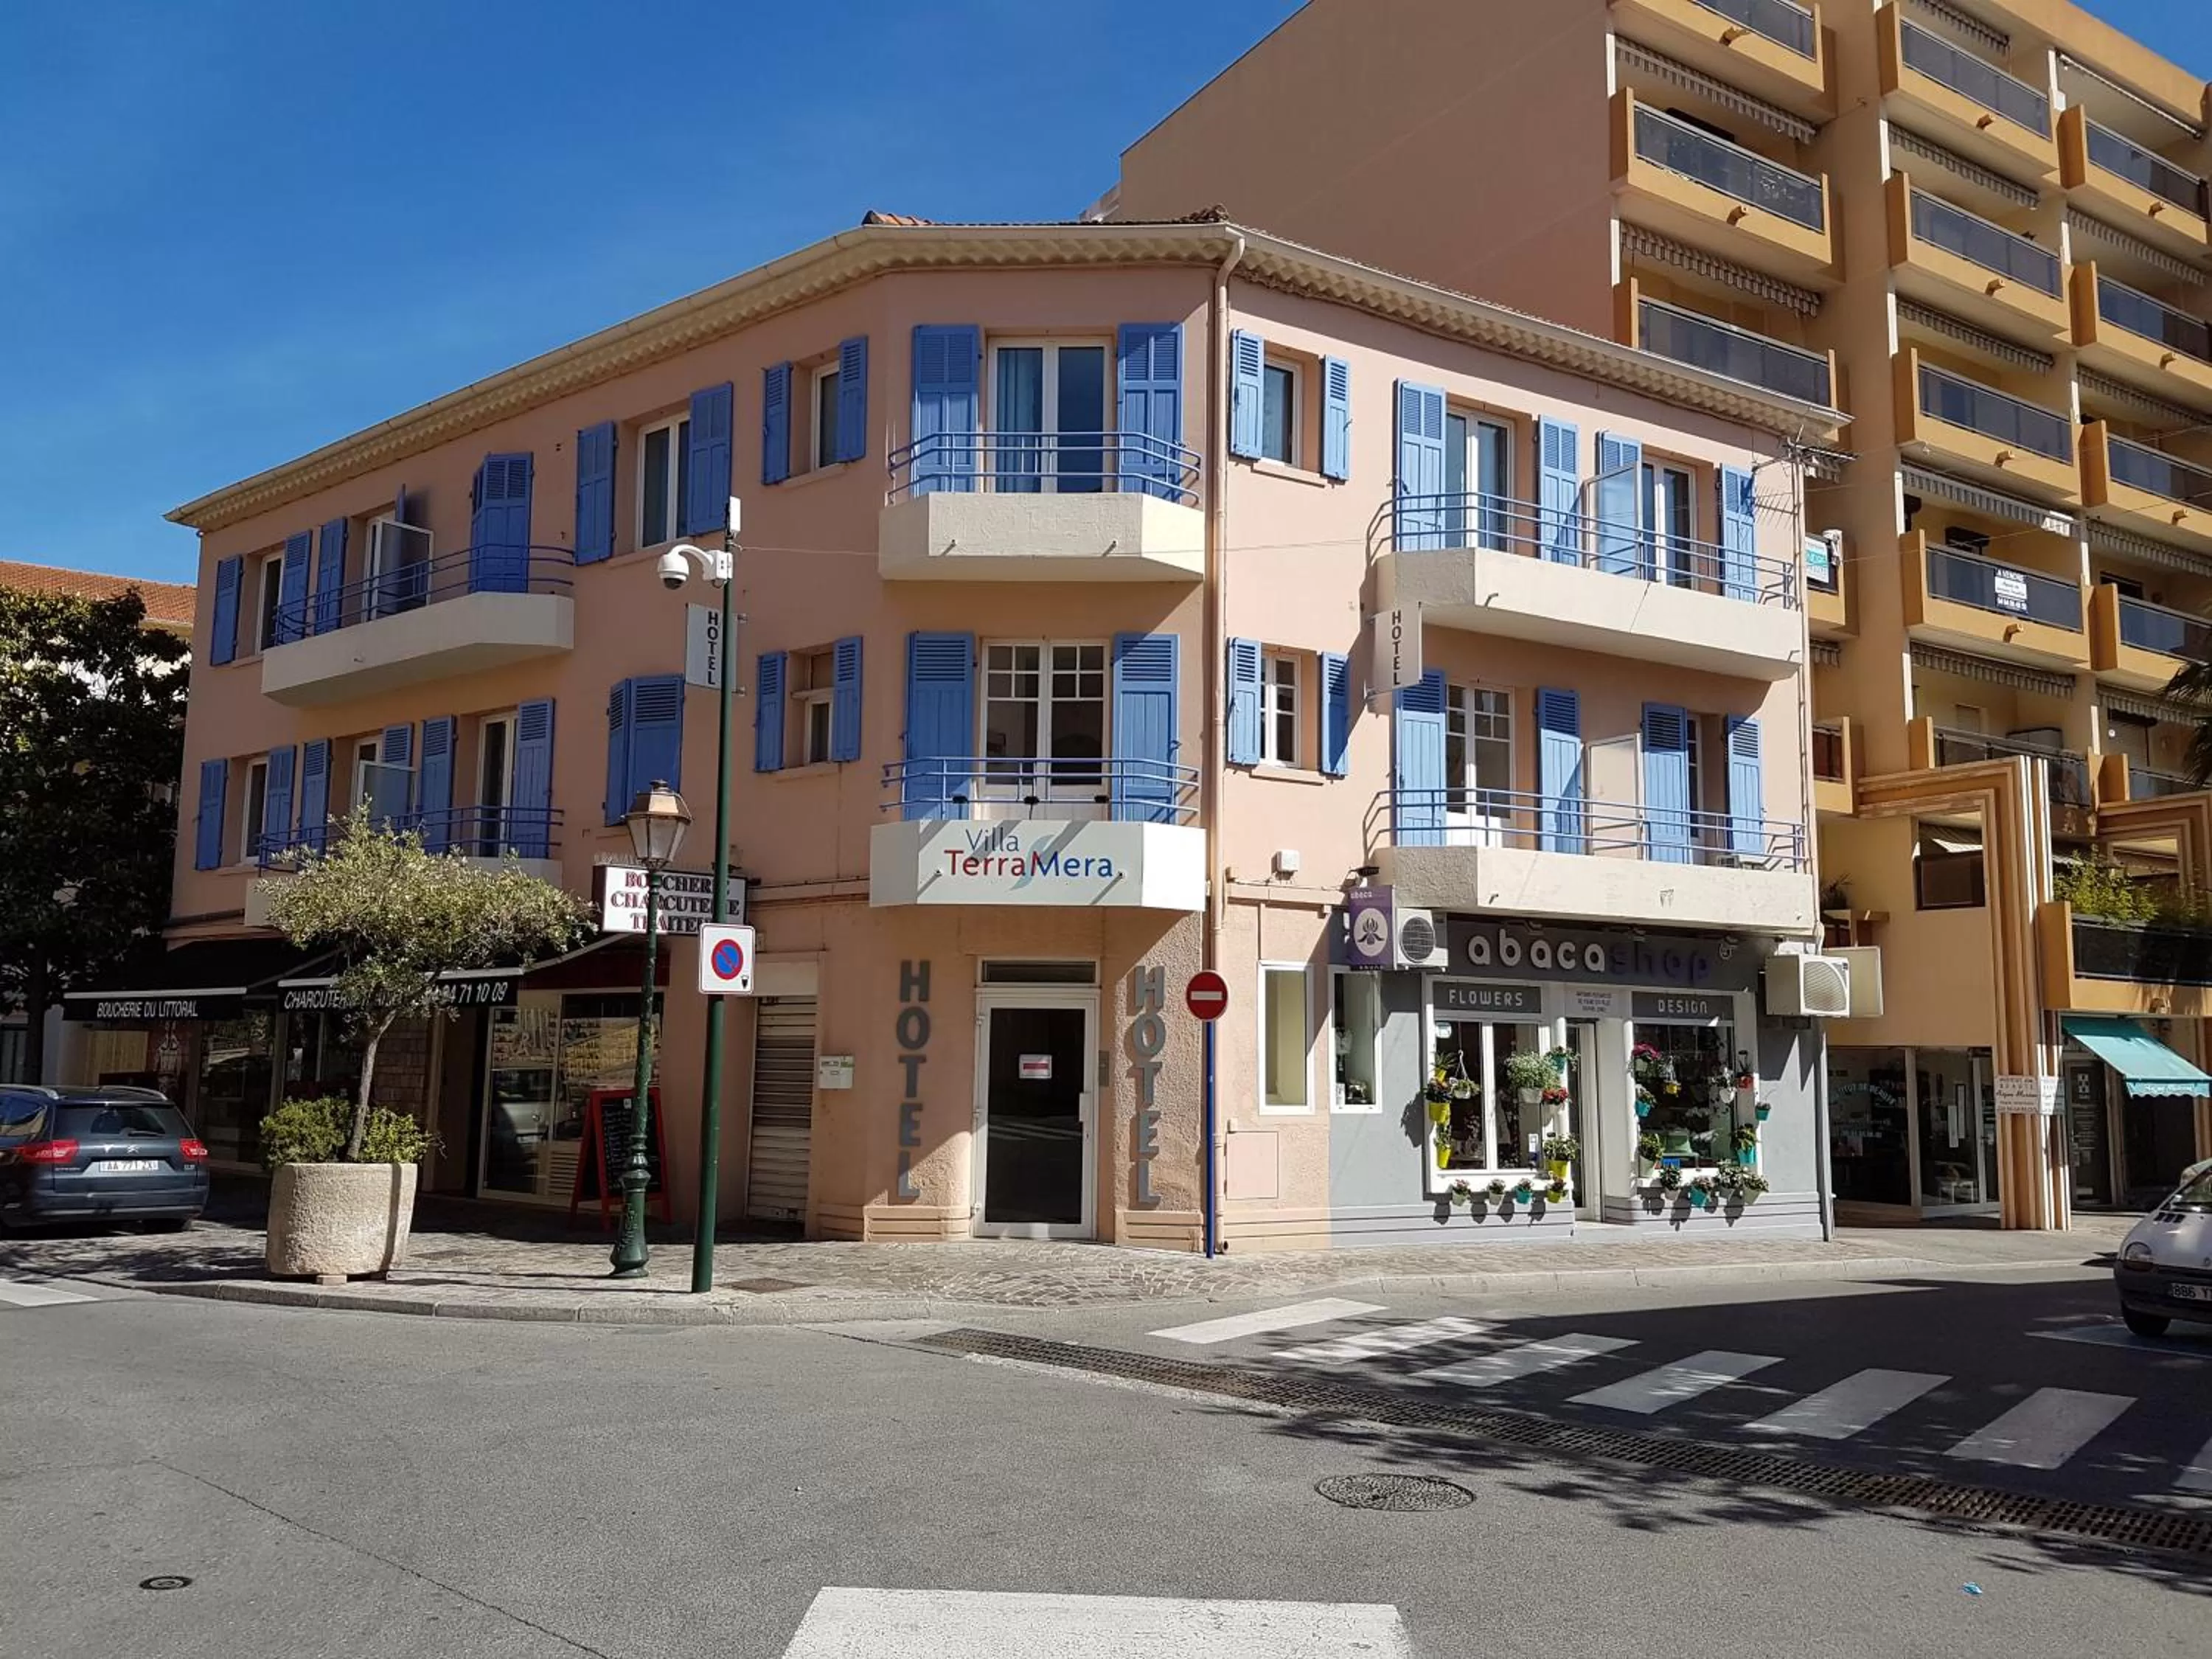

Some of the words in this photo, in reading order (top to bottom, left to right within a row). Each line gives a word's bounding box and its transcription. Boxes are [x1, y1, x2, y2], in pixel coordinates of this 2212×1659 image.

[707, 611, 719, 686] HOTEL
[1391, 610, 1402, 686] HOTEL
[965, 827, 1020, 852] Villa
[625, 872, 730, 896] BOCHER
[458, 983, 472, 1004] 71
[476, 983, 490, 1004] 10
[491, 981, 508, 1002] 09
[1449, 989, 1523, 1007] FLOWERS
[97, 1001, 143, 1018] BOUCHERIE
[144, 1001, 156, 1017] DU
[158, 1000, 198, 1017] LITTORAL
[896, 960, 931, 1199] HOTEL
[1132, 965, 1166, 1205] HOTEL
